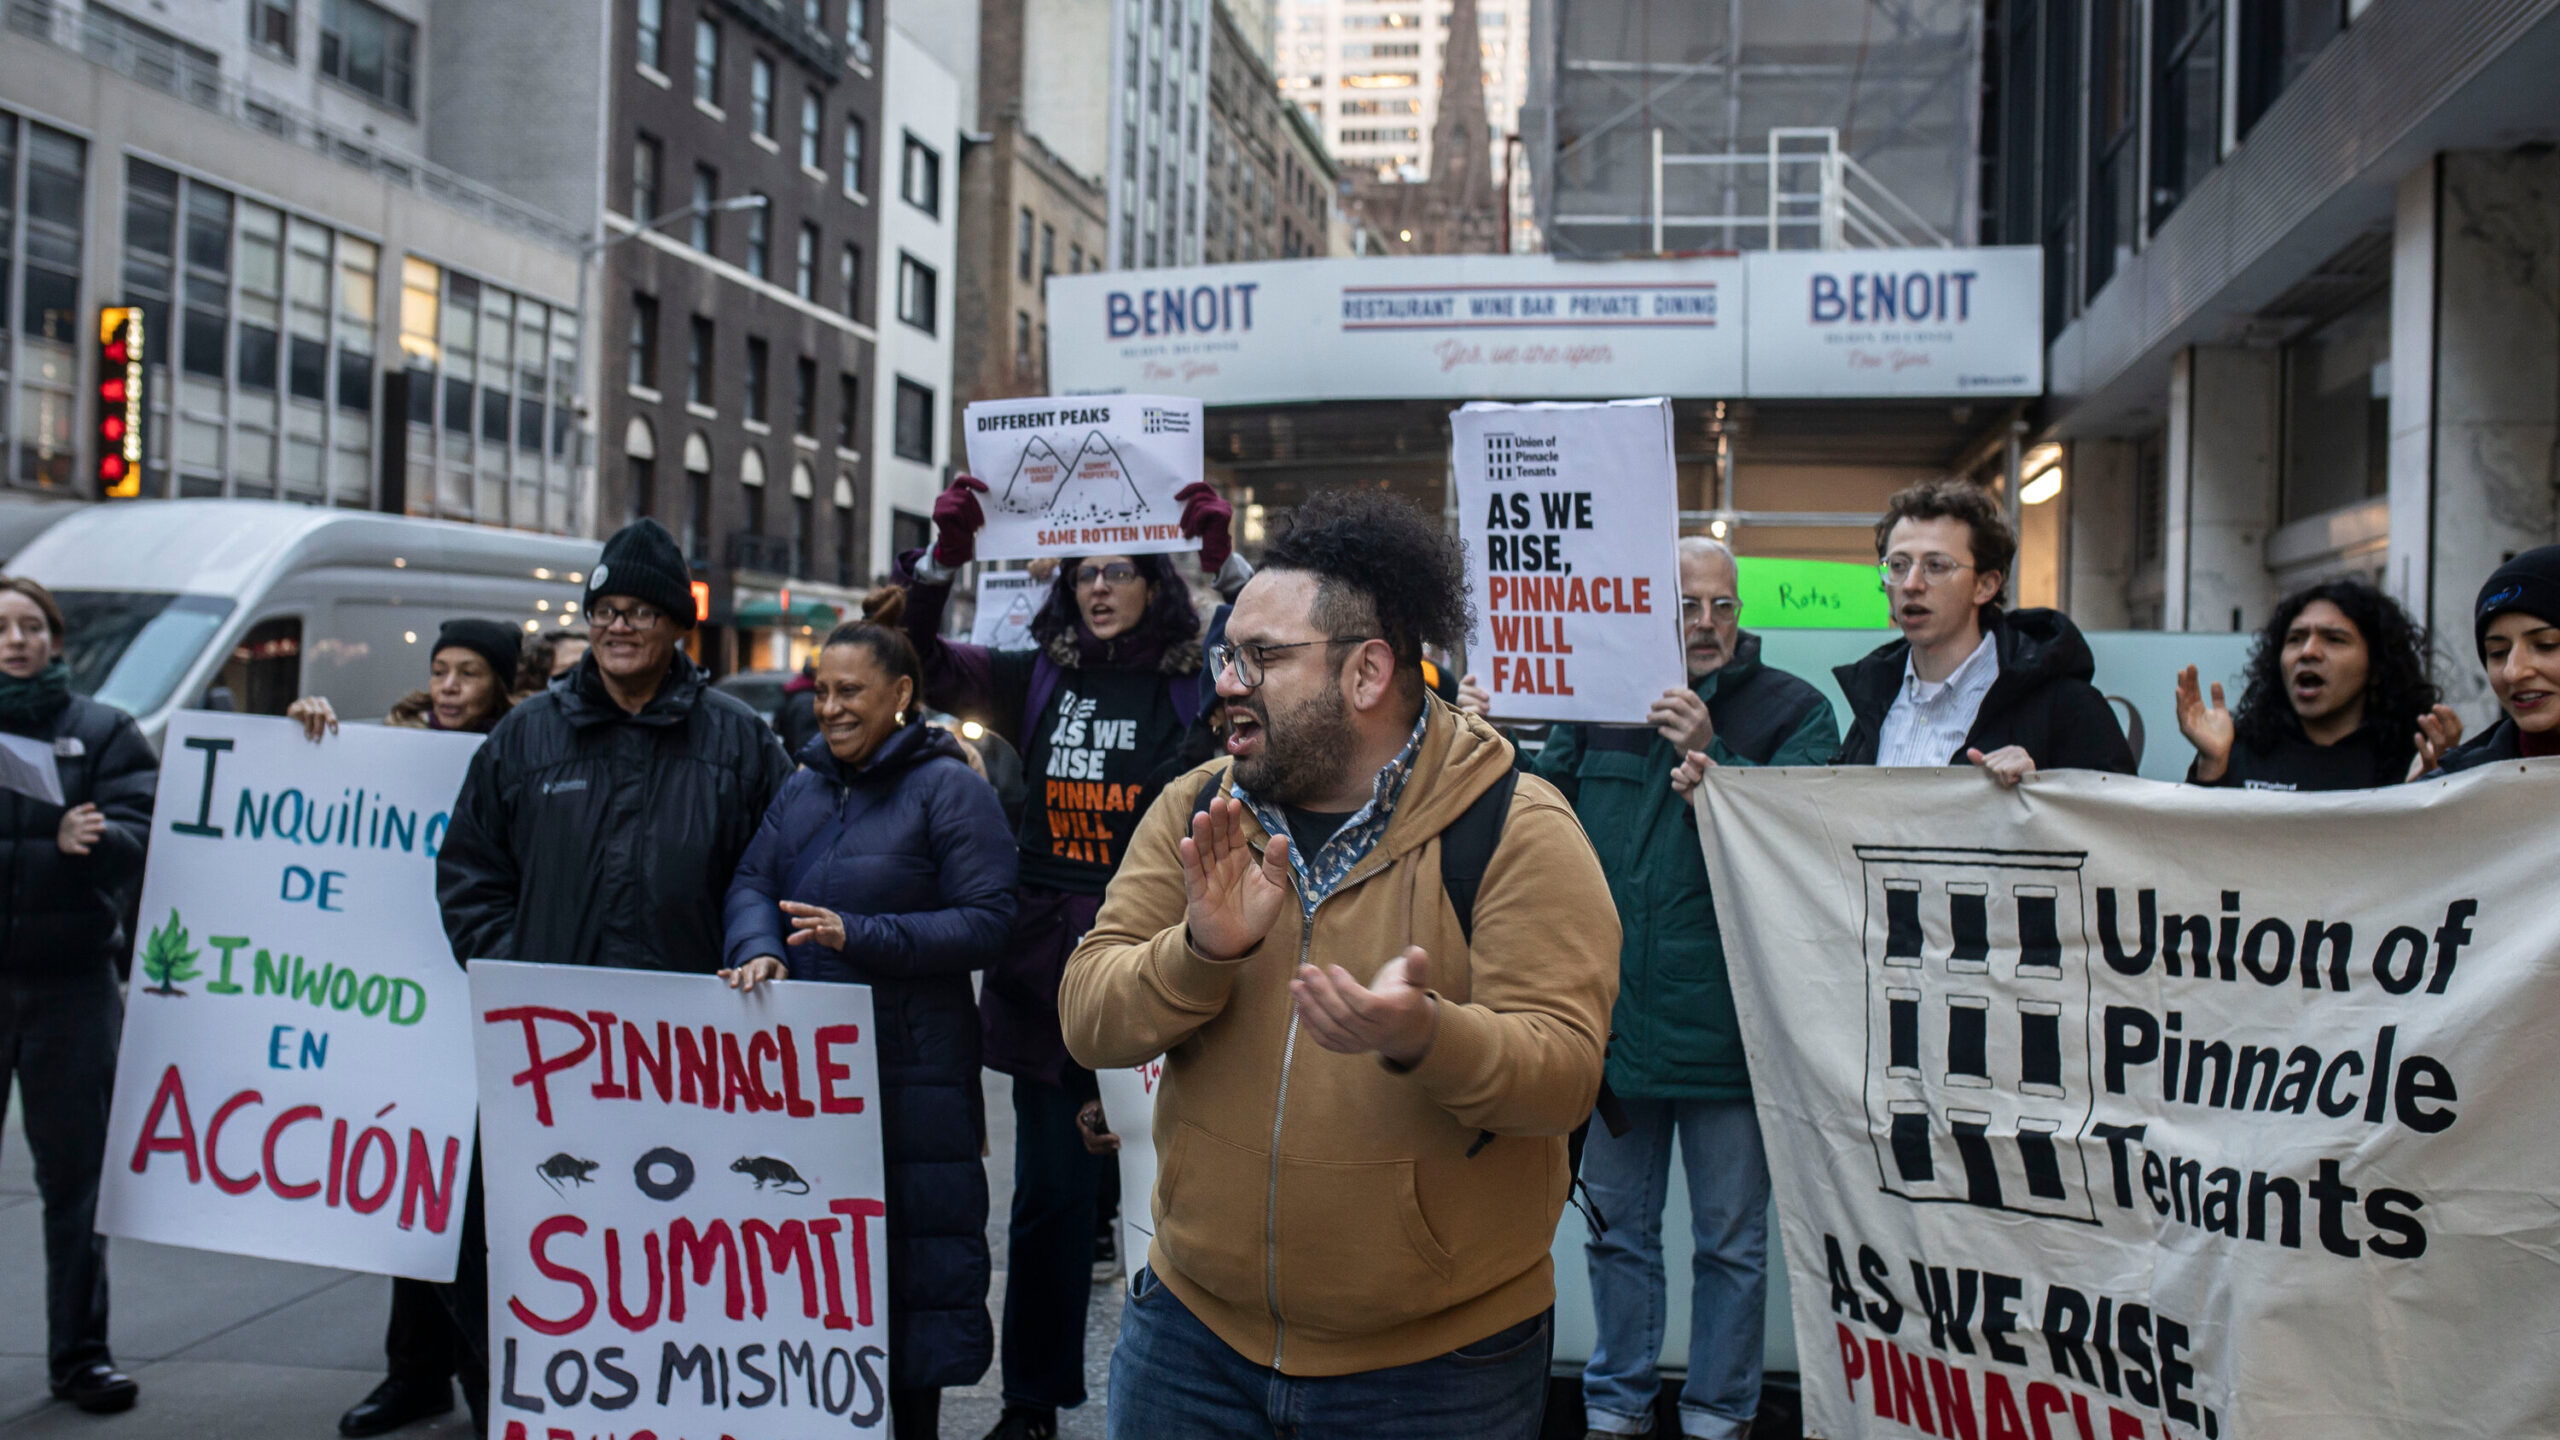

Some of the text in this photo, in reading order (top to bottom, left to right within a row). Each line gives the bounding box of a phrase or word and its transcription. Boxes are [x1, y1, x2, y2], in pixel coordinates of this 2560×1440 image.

[1107, 283, 1259, 340] BENOIT
[1342, 296, 1717, 320] RESTAURANT WINE BAR PRIVATE DINING
[1809, 271, 1977, 325] BENOIT
[977, 408, 1110, 432] DIFFERENT PEAKS
[1515, 435, 1556, 448] Union of
[1516, 451, 1559, 462] Pinnacle
[1517, 466, 1556, 477] Tenants
[1487, 492, 1593, 530] AS WE
[1037, 524, 1185, 546] SAME ROTTEN VIEW
[1488, 534, 1572, 577] RISE,
[1489, 576, 1652, 614] PINNACLE
[1490, 615, 1573, 654] WILL
[1492, 657, 1574, 696] FALL
[1049, 716, 1137, 750] AS WE
[1047, 809, 1113, 840] WILL
[281, 865, 348, 912] DE
[2096, 887, 2478, 995] Union of
[205, 936, 427, 1026] INWOOD
[268, 1025, 329, 1070] EN
[484, 1006, 865, 1127] PINNACLE
[2104, 1005, 2458, 1133] Pinnacle
[130, 1064, 460, 1234] ACCIÓN
[633, 1147, 695, 1201] O
[2090, 1122, 2427, 1259] Tenants
[508, 1198, 886, 1336] SUMMIT
[1824, 1233, 2219, 1440] AS WE RISE,
[501, 1338, 888, 1429] LOS MISMOS
